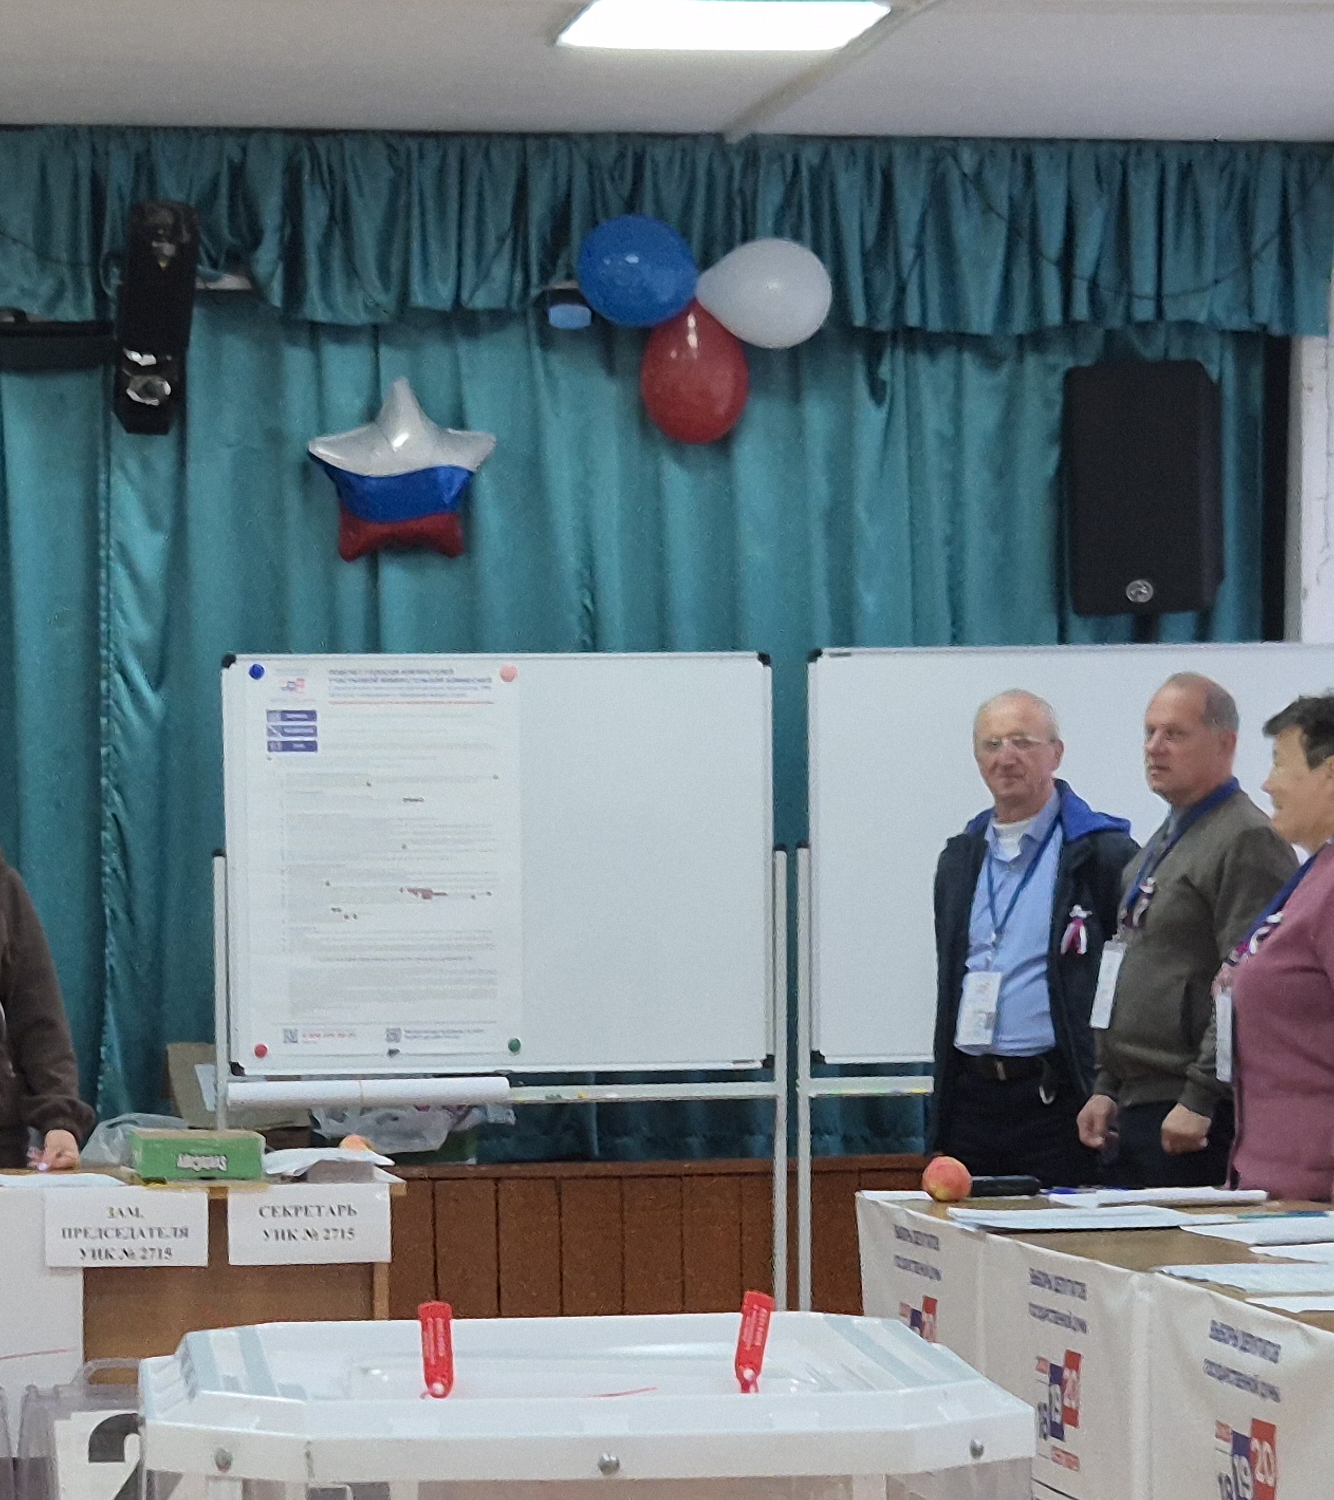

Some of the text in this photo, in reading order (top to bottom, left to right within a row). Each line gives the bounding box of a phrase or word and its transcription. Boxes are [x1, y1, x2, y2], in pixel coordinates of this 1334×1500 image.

[258, 1204, 358, 1218] СЕКРЕТАРЬ
[61, 1226, 189, 1240] ПРЕДСЕДАТЕЛЯ
[1233, 1454, 1254, 1500] 19
[1250, 1437, 1276, 1487] 20
